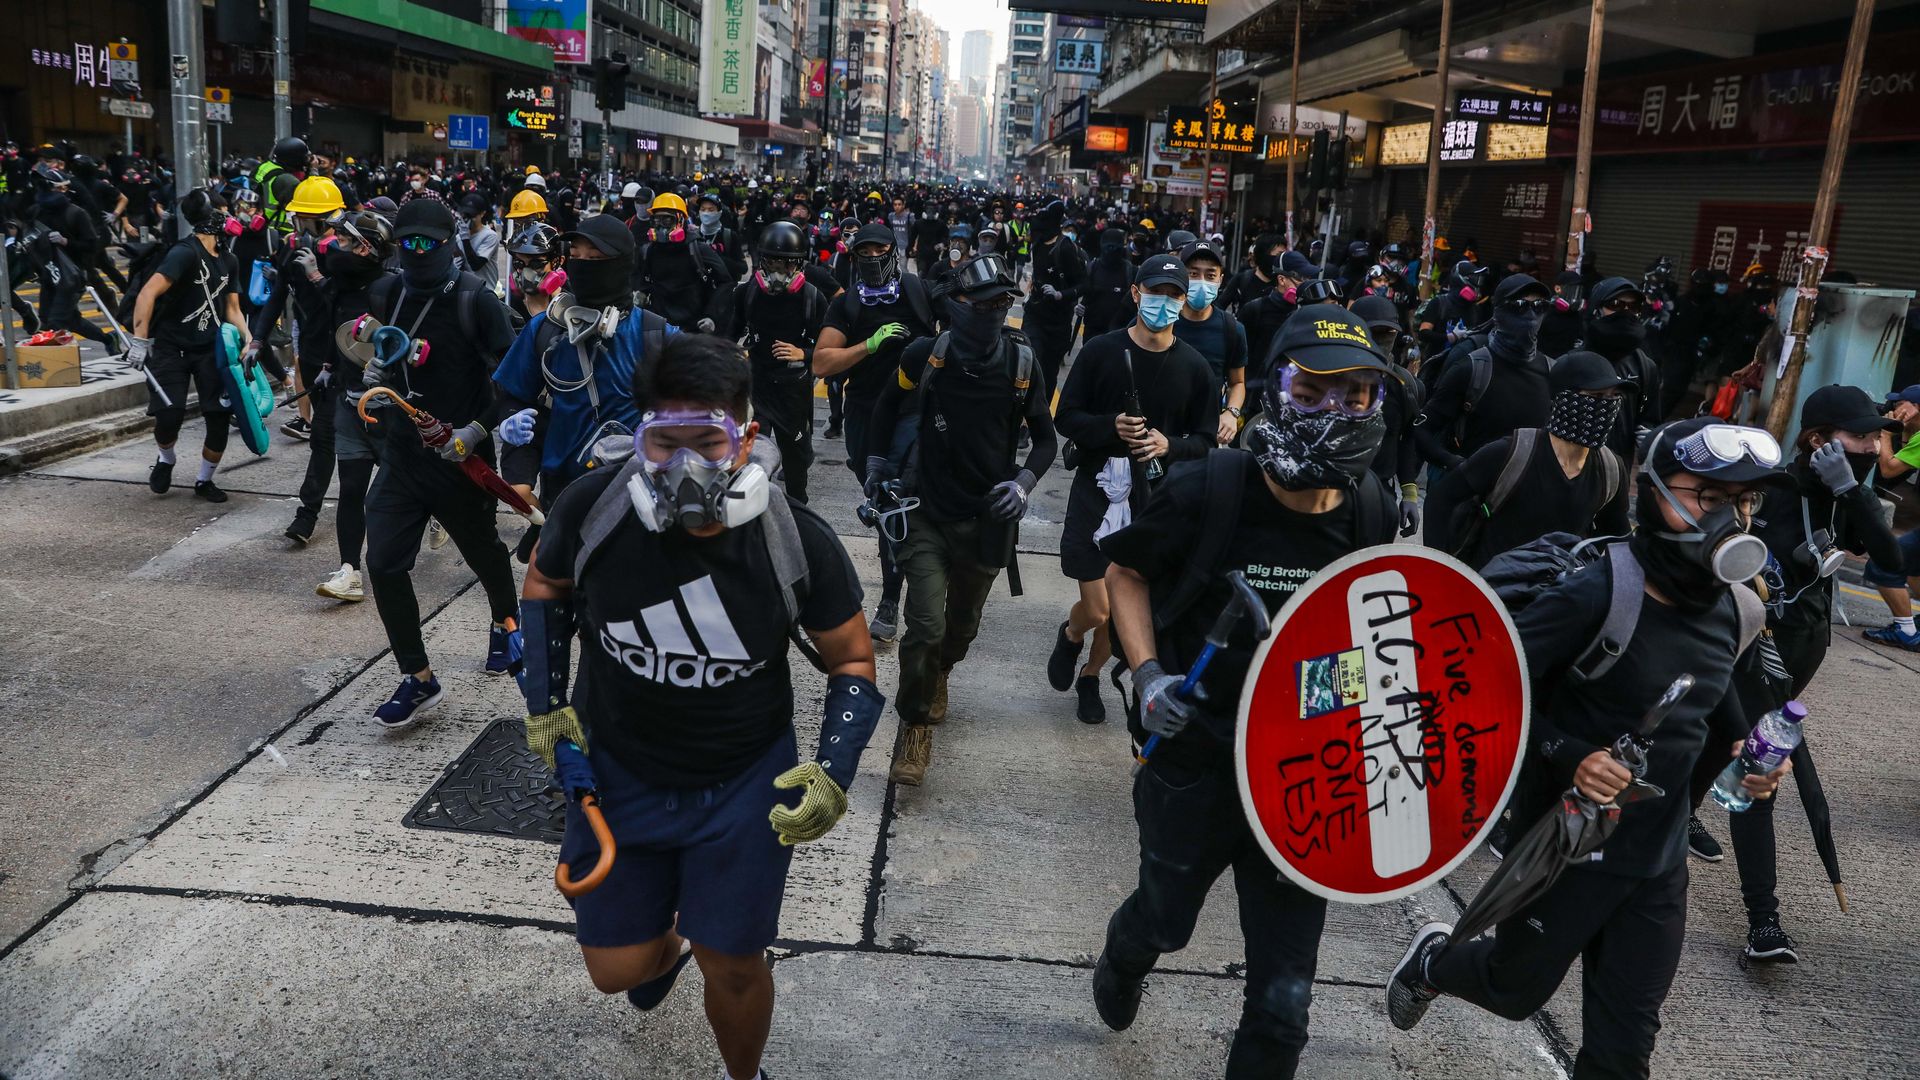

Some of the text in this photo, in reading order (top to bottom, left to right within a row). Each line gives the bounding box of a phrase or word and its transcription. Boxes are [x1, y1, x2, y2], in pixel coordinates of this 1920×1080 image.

[1058, 42, 1096, 62] 銀泉
[1510, 99, 1542, 113] 周大福
[1637, 75, 1744, 136] 周大福
[1766, 84, 1815, 107] CHOW
[1183, 140, 1198, 148] FENG
[1200, 142, 1219, 150] XING
[1220, 143, 1254, 153] JEWELLERY
[1503, 183, 1549, 208] 六福珠寶
[1313, 319, 1349, 331] Tiger
[1246, 564, 1319, 579] Big Brothe
[1246, 578, 1303, 592] watchin
[599, 628, 768, 690] adidas
[1429, 613, 1500, 841] Five demands
[1347, 713, 1390, 818] NOT
[1277, 752, 1322, 861] LESS
[1321, 739, 1360, 854] ONE
